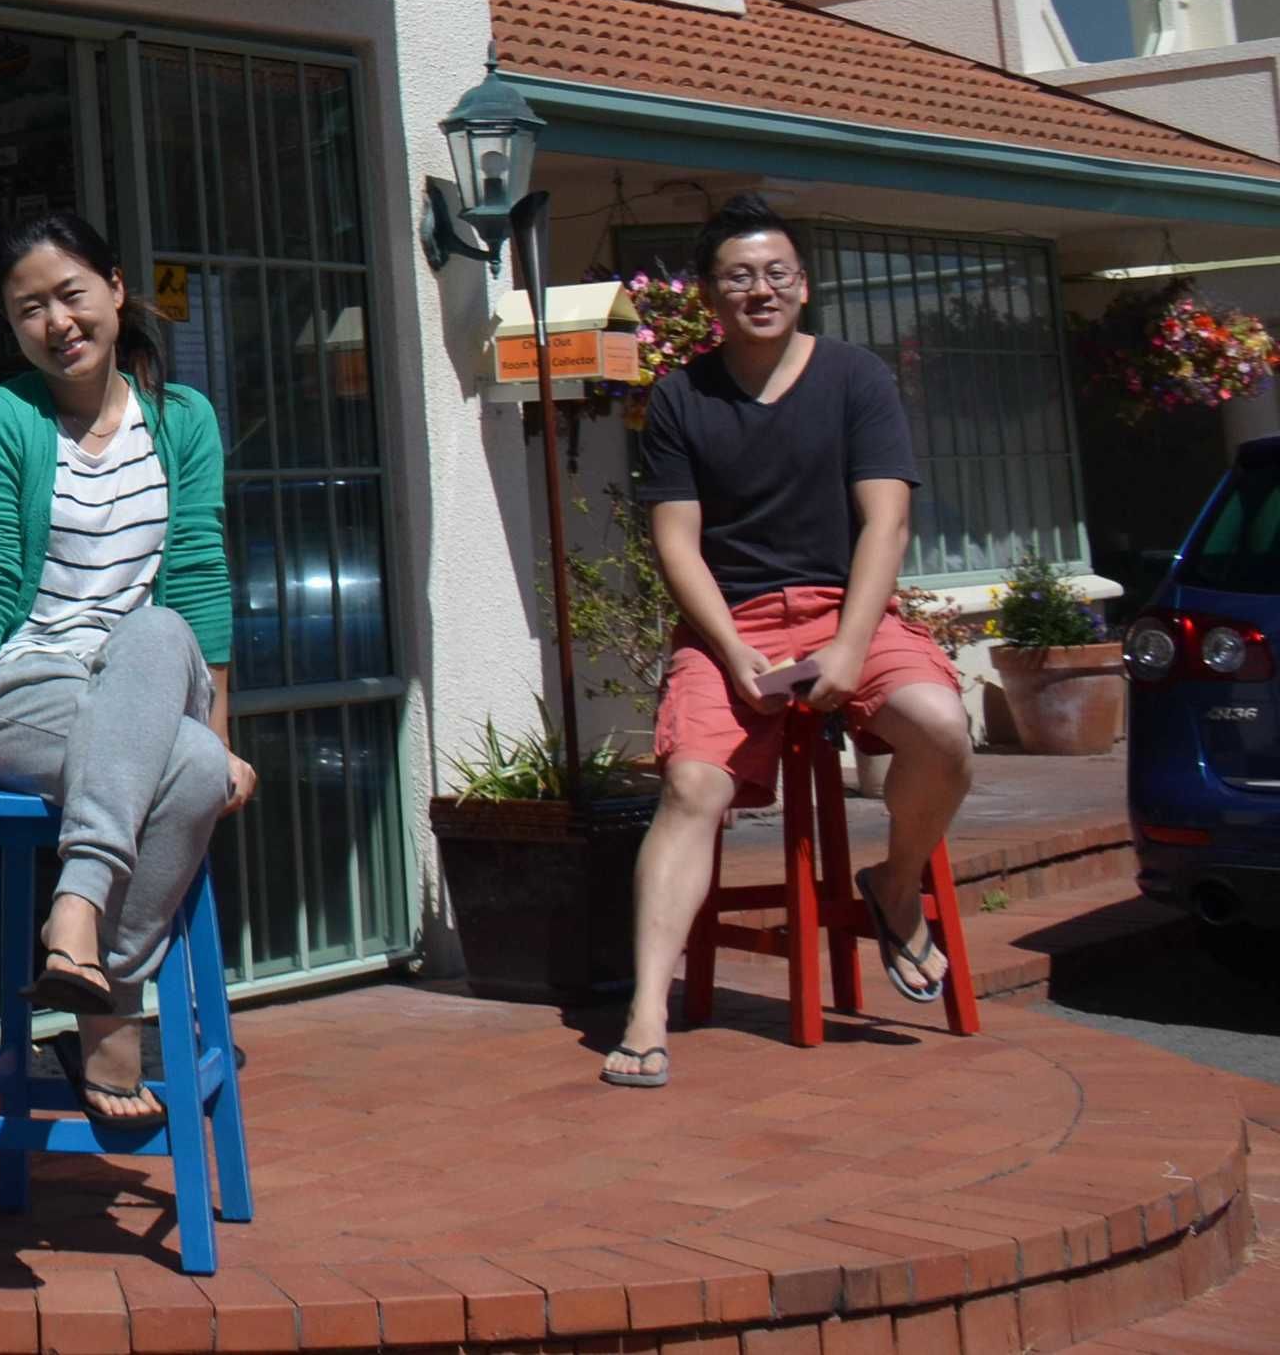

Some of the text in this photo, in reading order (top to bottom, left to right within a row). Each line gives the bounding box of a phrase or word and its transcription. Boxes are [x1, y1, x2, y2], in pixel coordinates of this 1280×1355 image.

[553, 337, 572, 347] Out
[502, 359, 529, 370] Room
[551, 356, 597, 367] Collector
